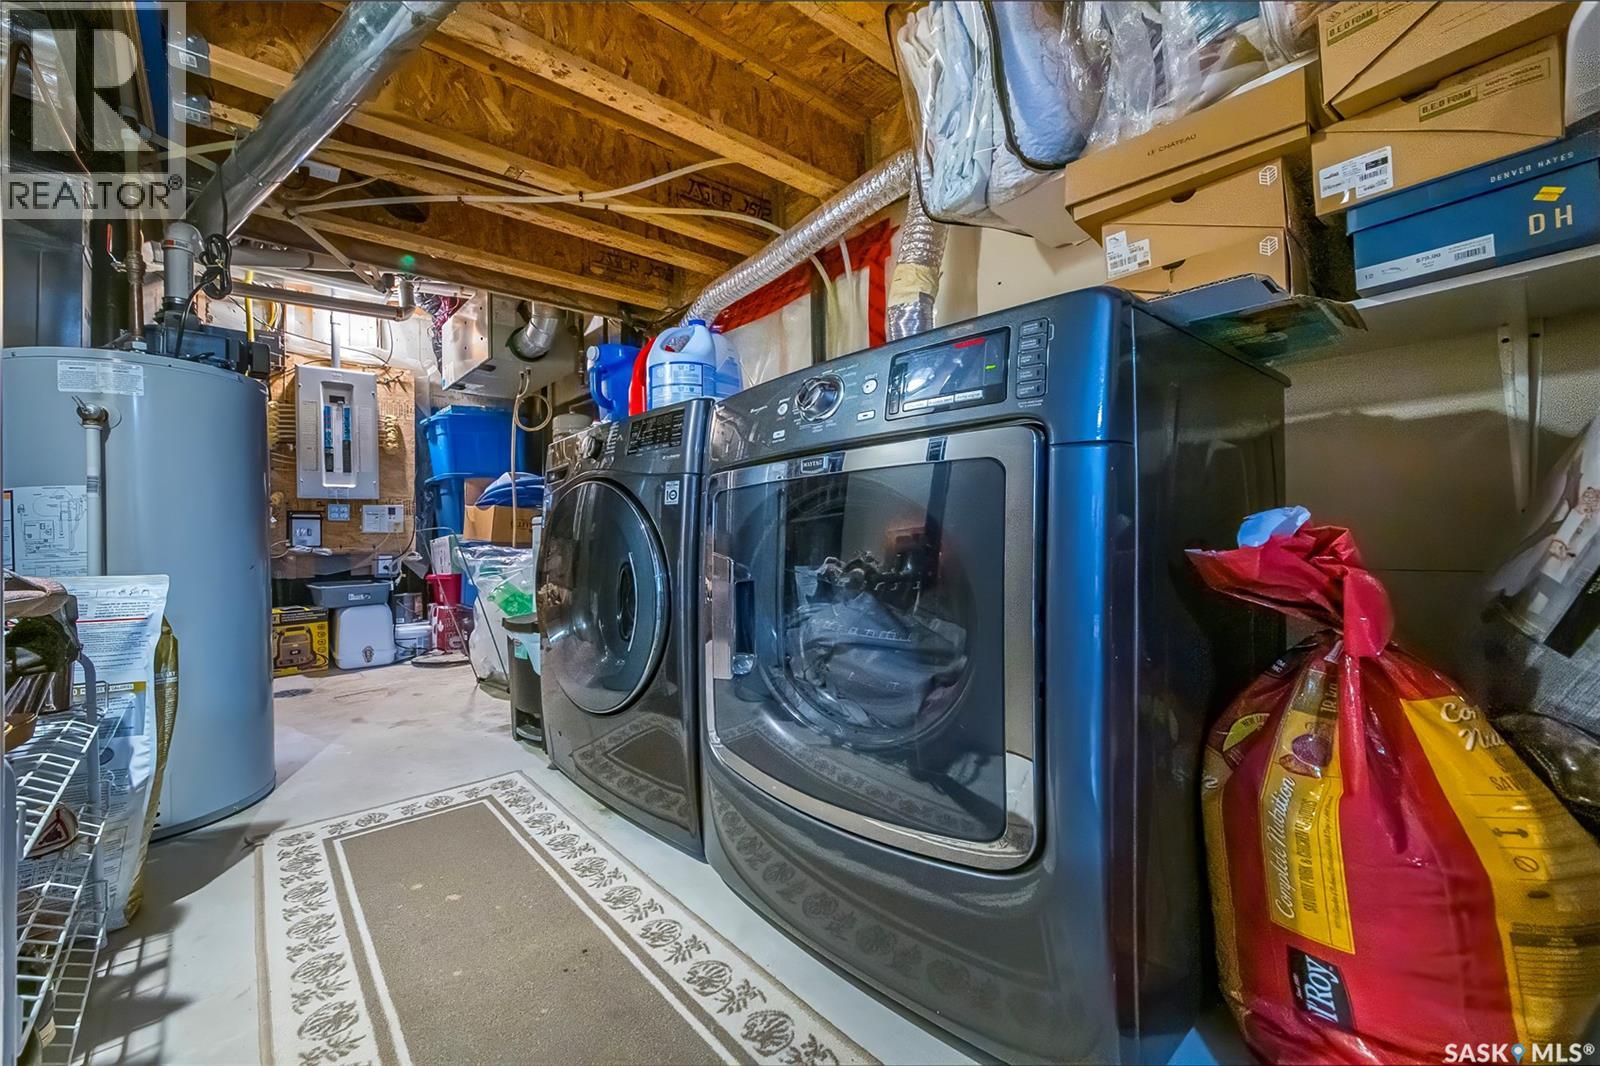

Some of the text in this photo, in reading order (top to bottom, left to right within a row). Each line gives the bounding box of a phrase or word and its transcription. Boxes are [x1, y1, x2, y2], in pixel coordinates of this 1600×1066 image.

[1490, 151, 1574, 183] DENVER HAYES
[1266, 776, 1297, 919] Complete Nutrition
[1305, 954, 1340, 1024] l'Roy
